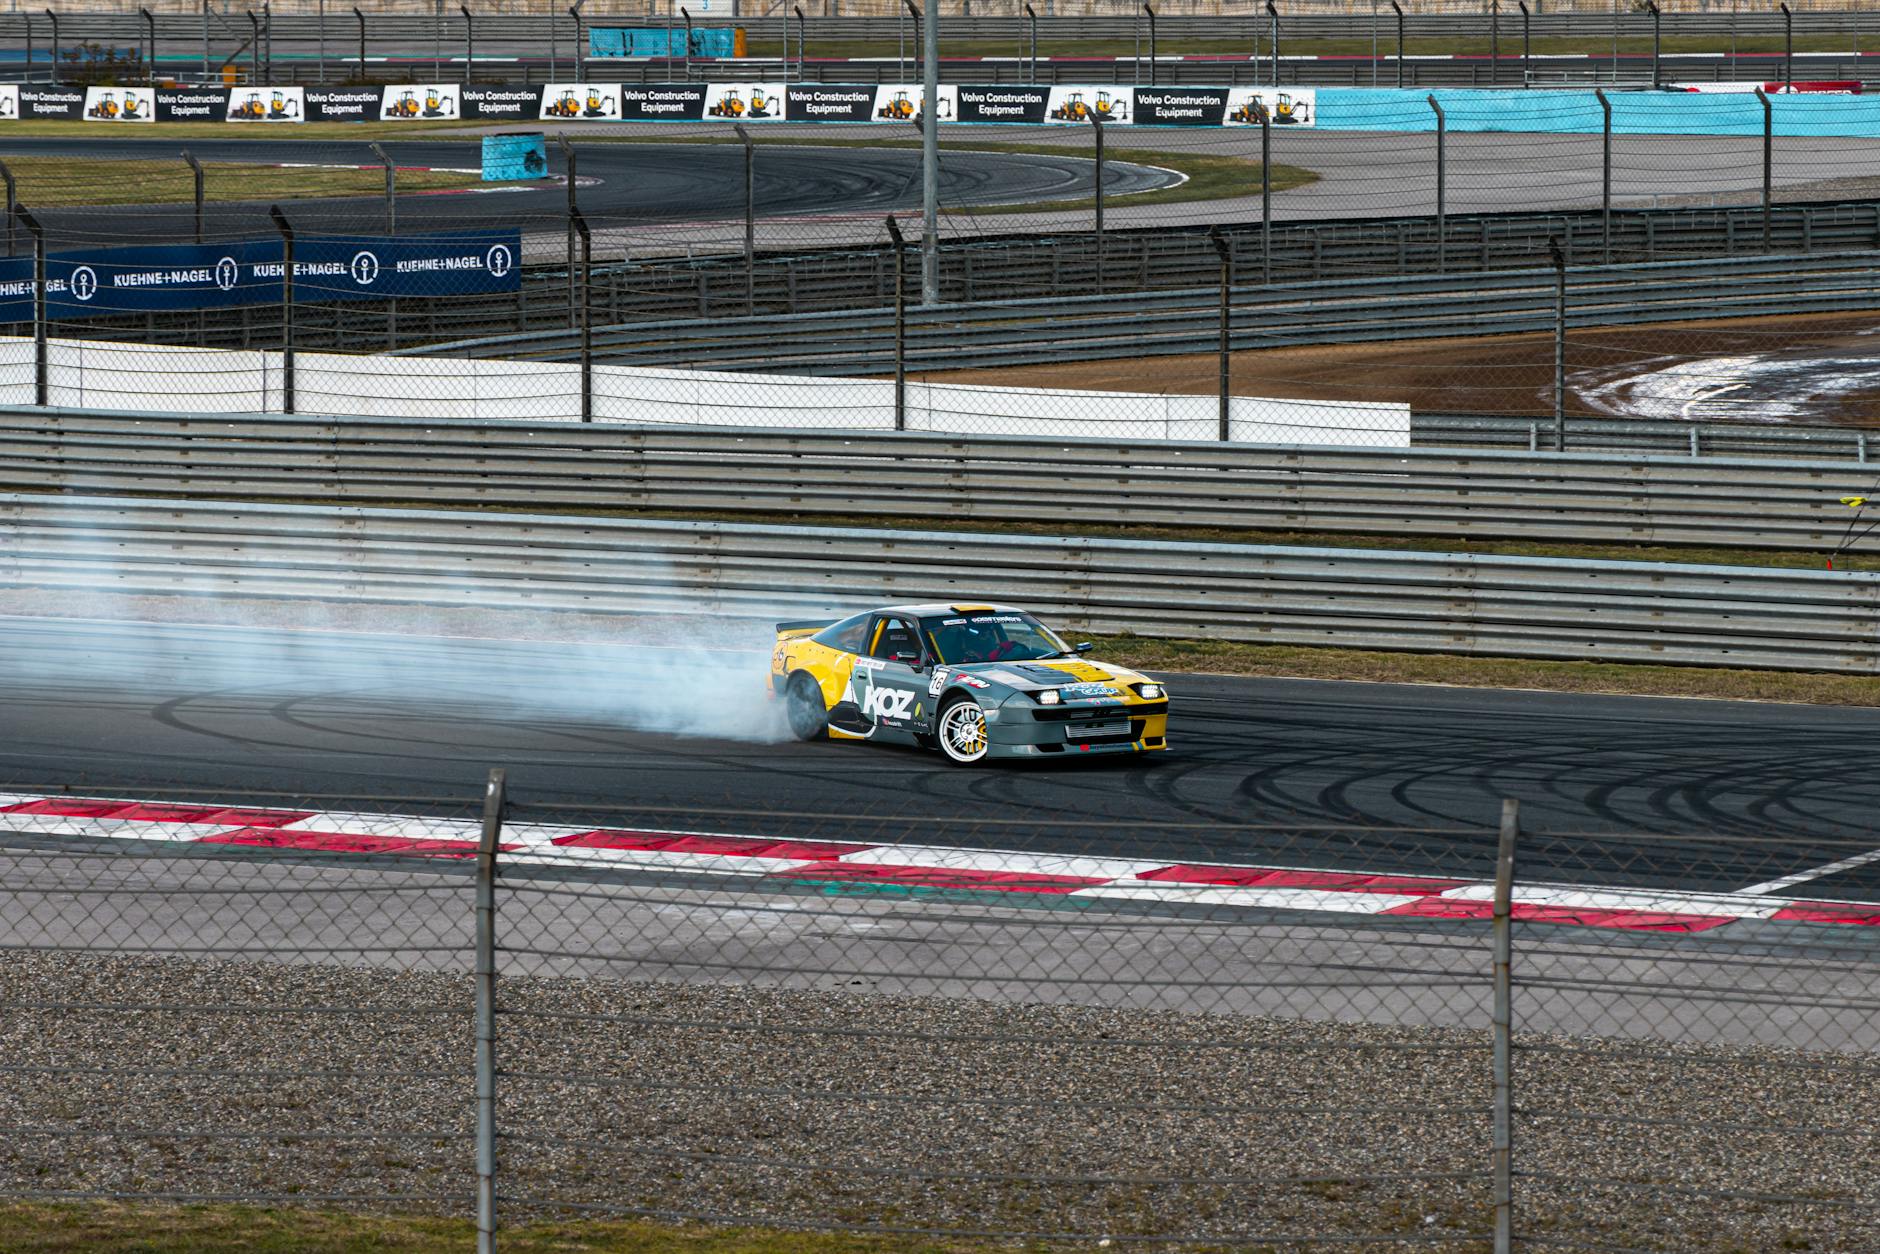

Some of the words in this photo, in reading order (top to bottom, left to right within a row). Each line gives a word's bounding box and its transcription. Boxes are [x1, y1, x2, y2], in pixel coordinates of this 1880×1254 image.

[20, 92, 38, 101] Volvo
[39, 92, 82, 101] Construction
[157, 95, 176, 103] Volvo
[177, 95, 224, 103] Construction
[306, 93, 327, 102] Volvo
[328, 93, 378, 102] Construction
[463, 91, 484, 100] Volvo
[486, 91, 536, 100] Construction
[625, 91, 647, 100] Volvo
[648, 91, 700, 100] Construction
[790, 92, 812, 102] Volvo
[814, 92, 869, 102] Construction
[961, 93, 985, 103] Volvo
[986, 93, 1042, 103] Construction
[1138, 95, 1162, 105] Volvo
[1164, 95, 1220, 105] Construction
[33, 103, 68, 113] Equipment
[171, 106, 209, 115] Equipment
[322, 104, 362, 115] Equipment
[479, 103, 520, 114] Equipment
[641, 102, 684, 113] Equipment
[806, 104, 852, 115] Equipment
[979, 105, 1024, 116] Equipment
[1156, 107, 1202, 118] Equipment
[253, 262, 348, 277] KUEHE+NAGEL
[396, 256, 483, 273] KUEHNE+NAGEL
[113, 269, 213, 287] KUEHNE+NAGEL
[0, 279, 68, 296] HNE+GEL
[934, 677, 944, 690] 16
[862, 685, 916, 720] KOZ
